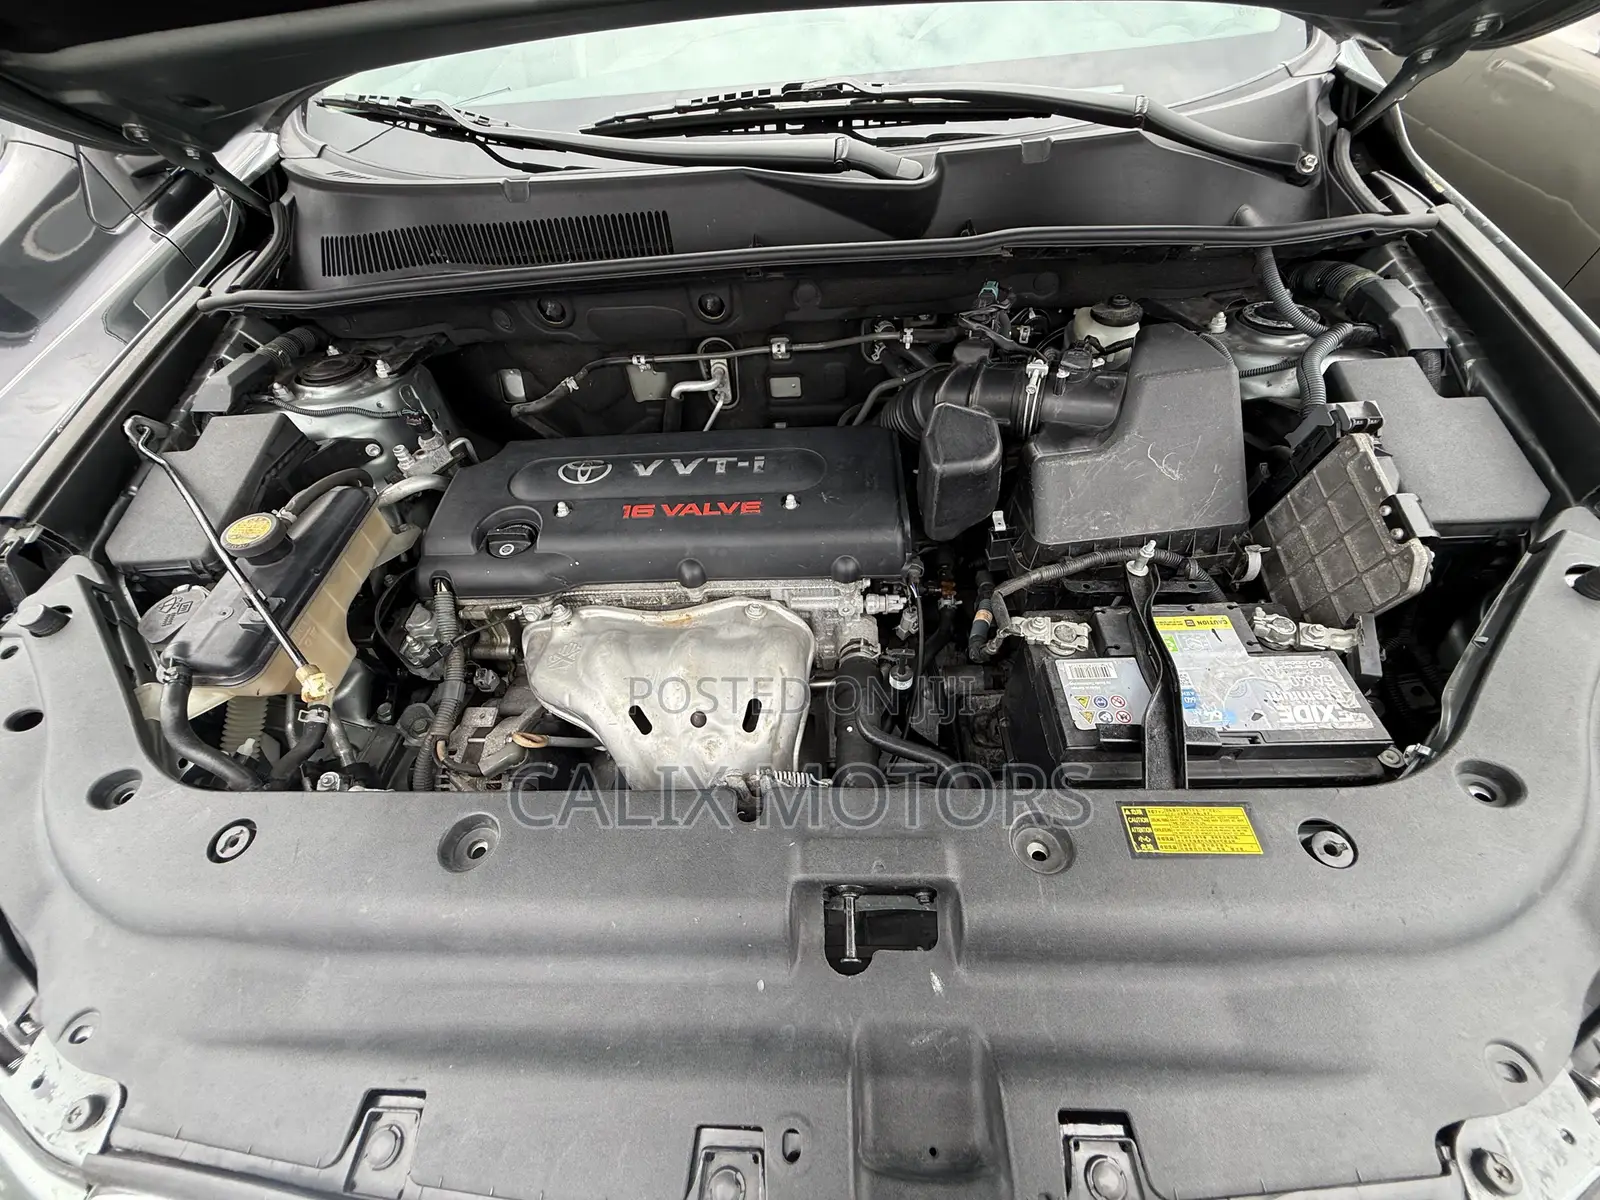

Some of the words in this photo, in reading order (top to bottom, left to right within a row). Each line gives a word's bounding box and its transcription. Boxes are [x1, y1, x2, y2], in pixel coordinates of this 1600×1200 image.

[631, 456, 765, 476] VVT-i
[622, 504, 656, 519] 16
[661, 501, 762, 517] VALVE
[1278, 705, 1356, 723] EXIDE
